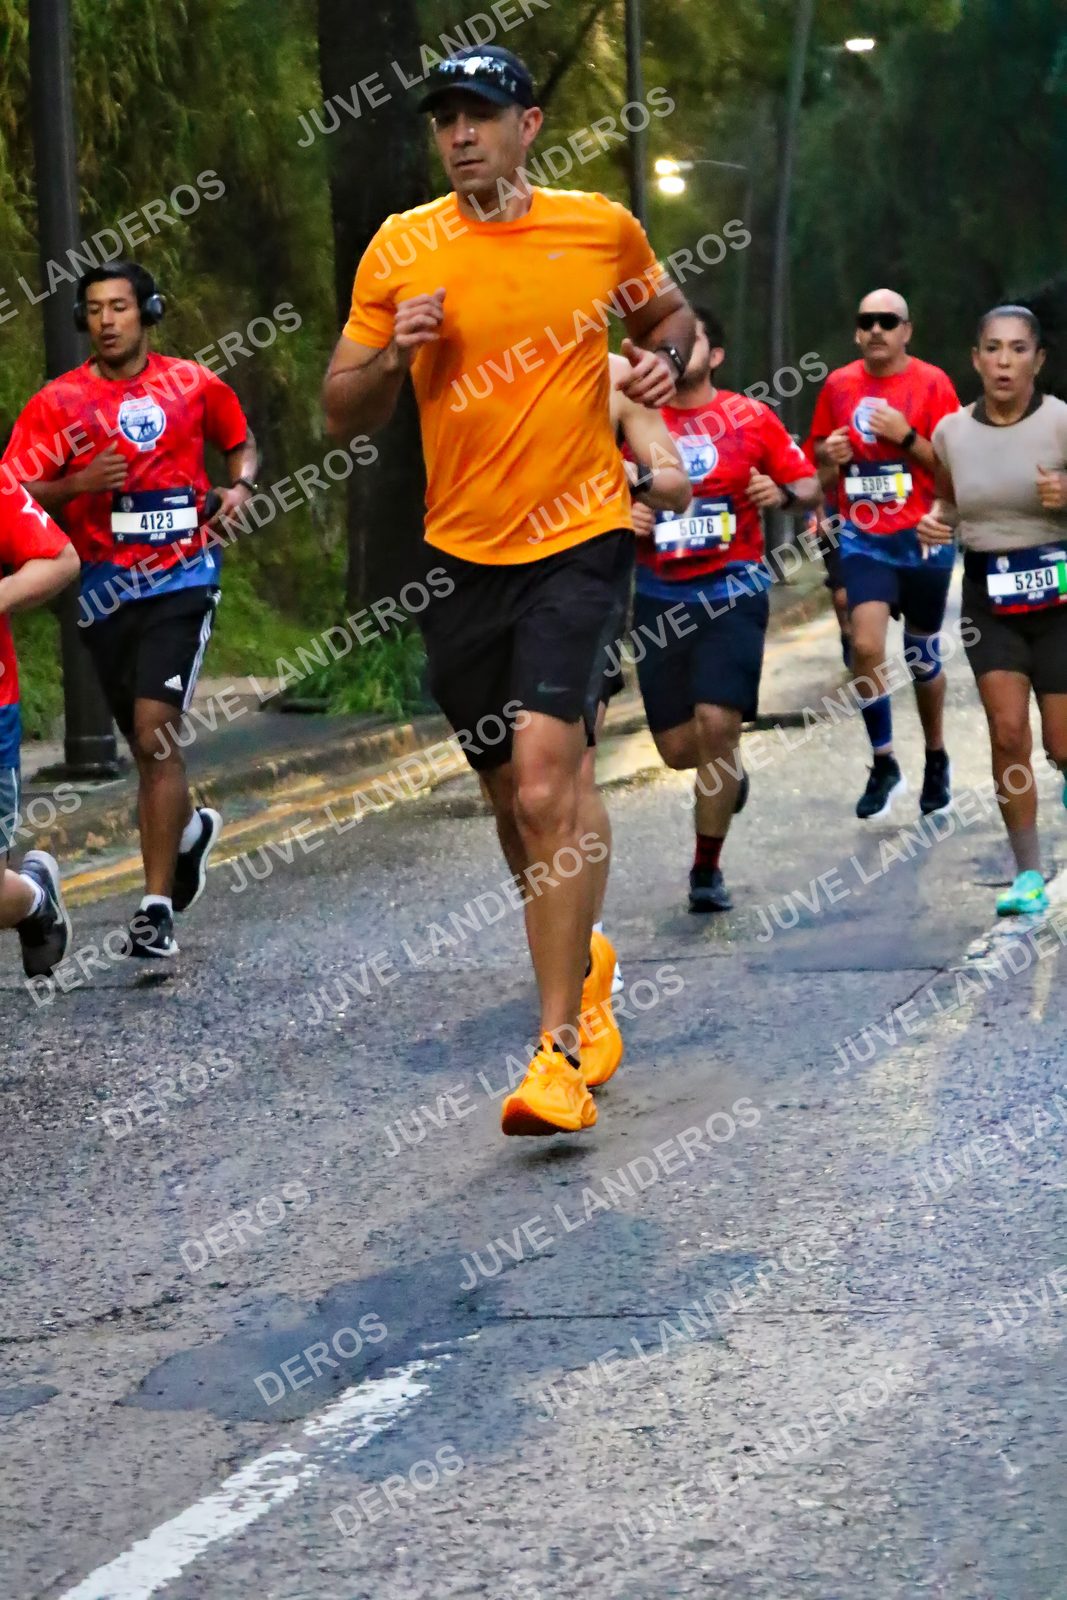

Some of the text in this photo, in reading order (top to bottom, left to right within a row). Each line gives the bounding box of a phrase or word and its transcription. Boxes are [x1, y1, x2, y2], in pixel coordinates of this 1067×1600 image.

[140, 512, 174, 530] 4123
[680, 518, 714, 536] 5076
[1015, 568, 1053, 590] 5250
